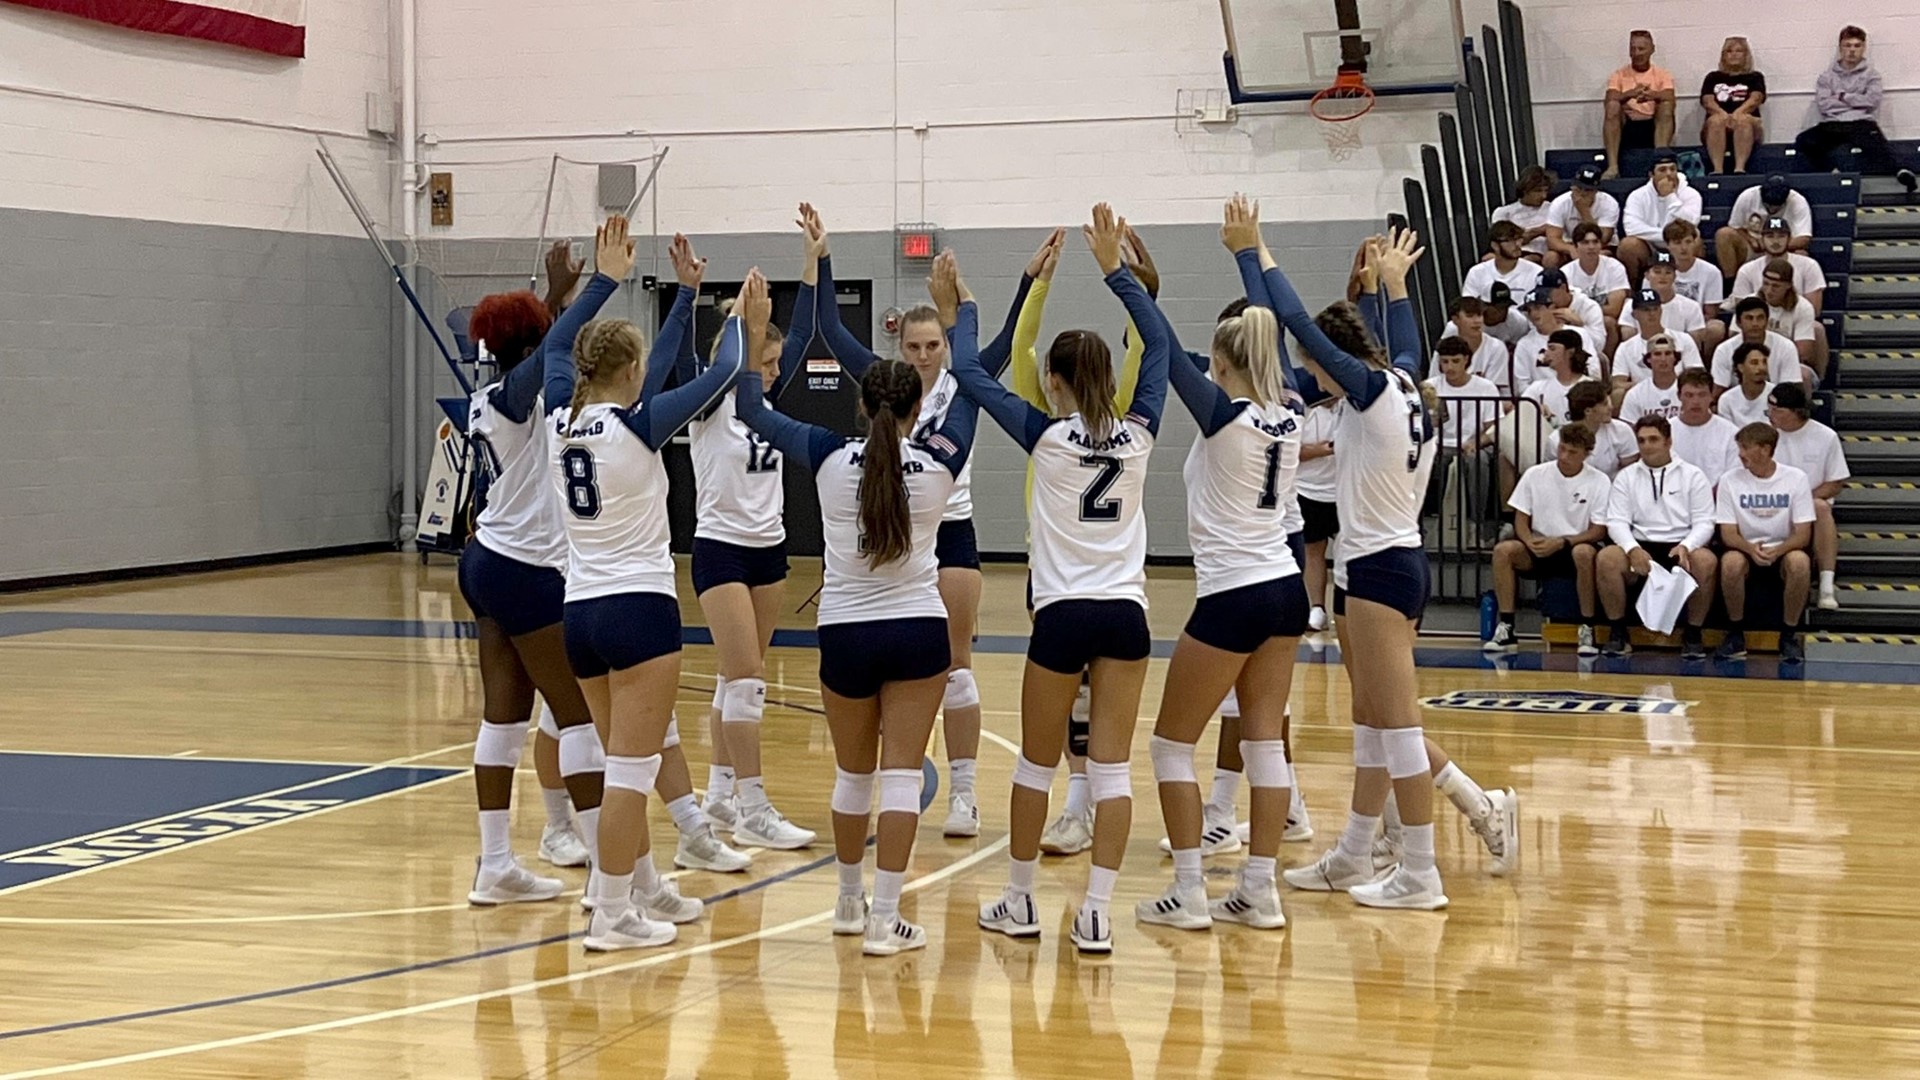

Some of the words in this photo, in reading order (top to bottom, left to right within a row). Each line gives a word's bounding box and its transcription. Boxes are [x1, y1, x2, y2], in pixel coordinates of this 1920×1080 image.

[560, 443, 602, 520] 8
[1079, 453, 1124, 522] 2
[1257, 440, 1284, 510] 1
[3, 799, 346, 867] MCCAA
